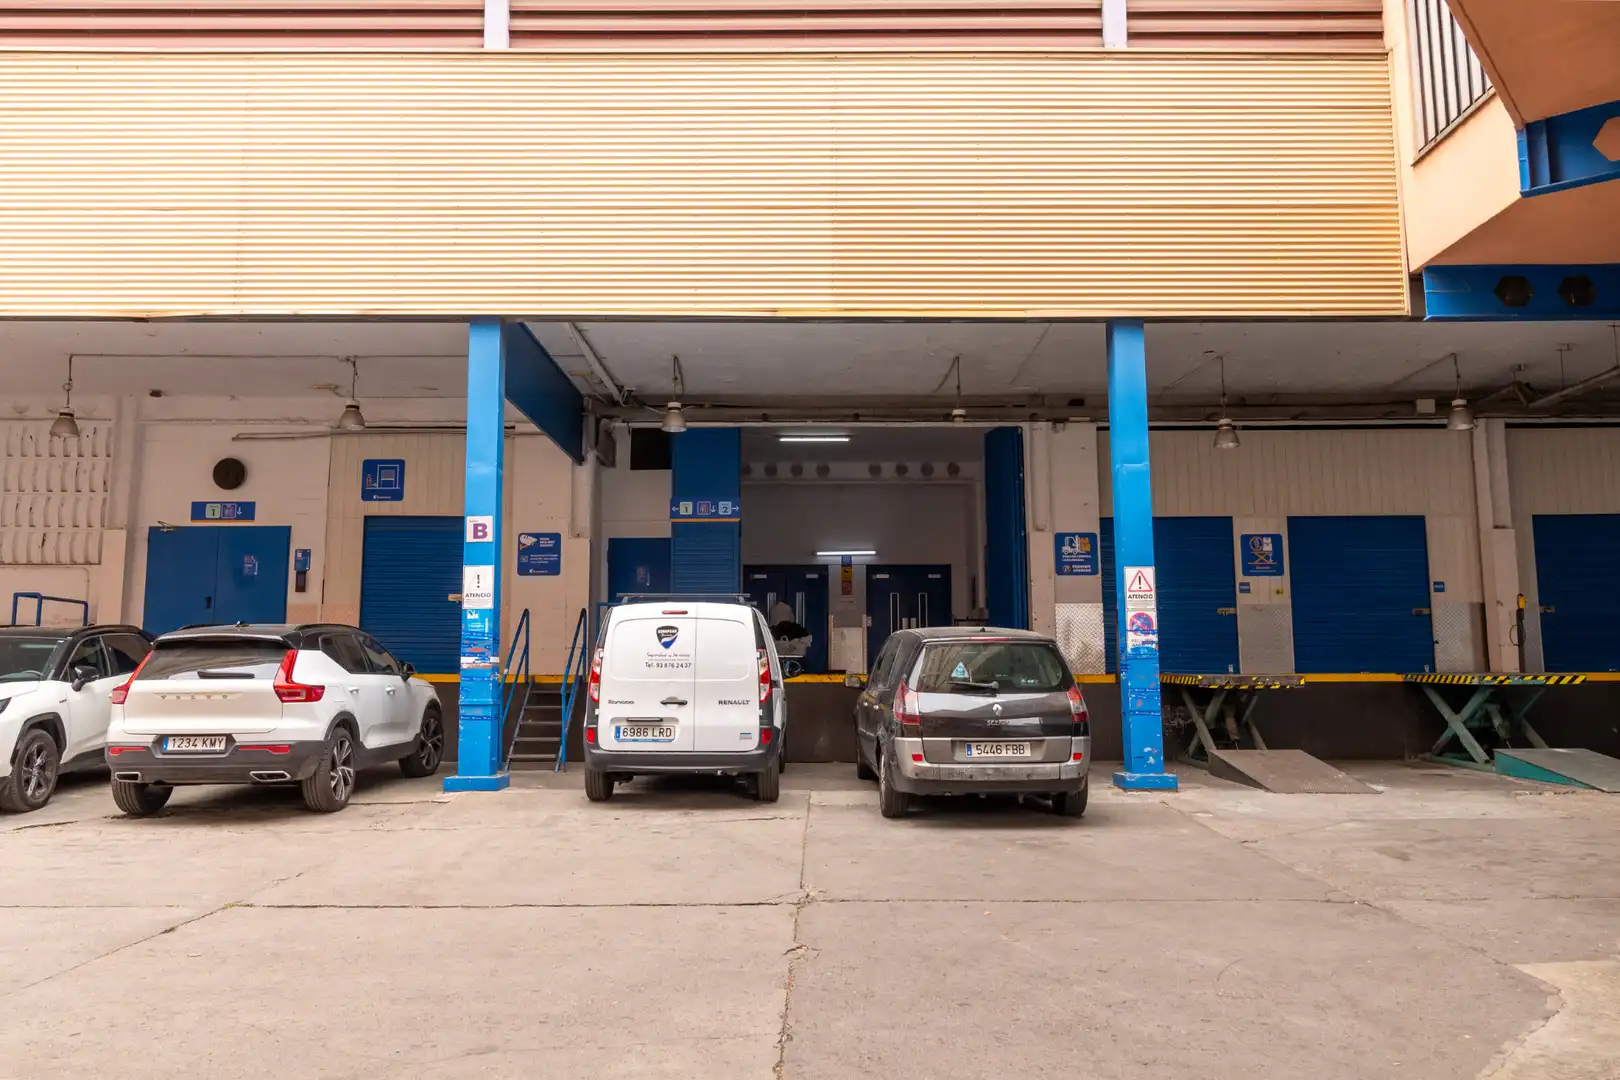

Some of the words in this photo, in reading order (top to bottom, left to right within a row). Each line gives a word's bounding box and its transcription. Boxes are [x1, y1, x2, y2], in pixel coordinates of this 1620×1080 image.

[211, 508, 216, 517] 1
[472, 523, 488, 540] B
[622, 727, 649, 738] 6986
[651, 727, 672, 738] LRD
[171, 738, 198, 749] 1234
[201, 738, 225, 748] KMY
[975, 744, 1002, 755] 5446
[1005, 744, 1025, 755] FBB
